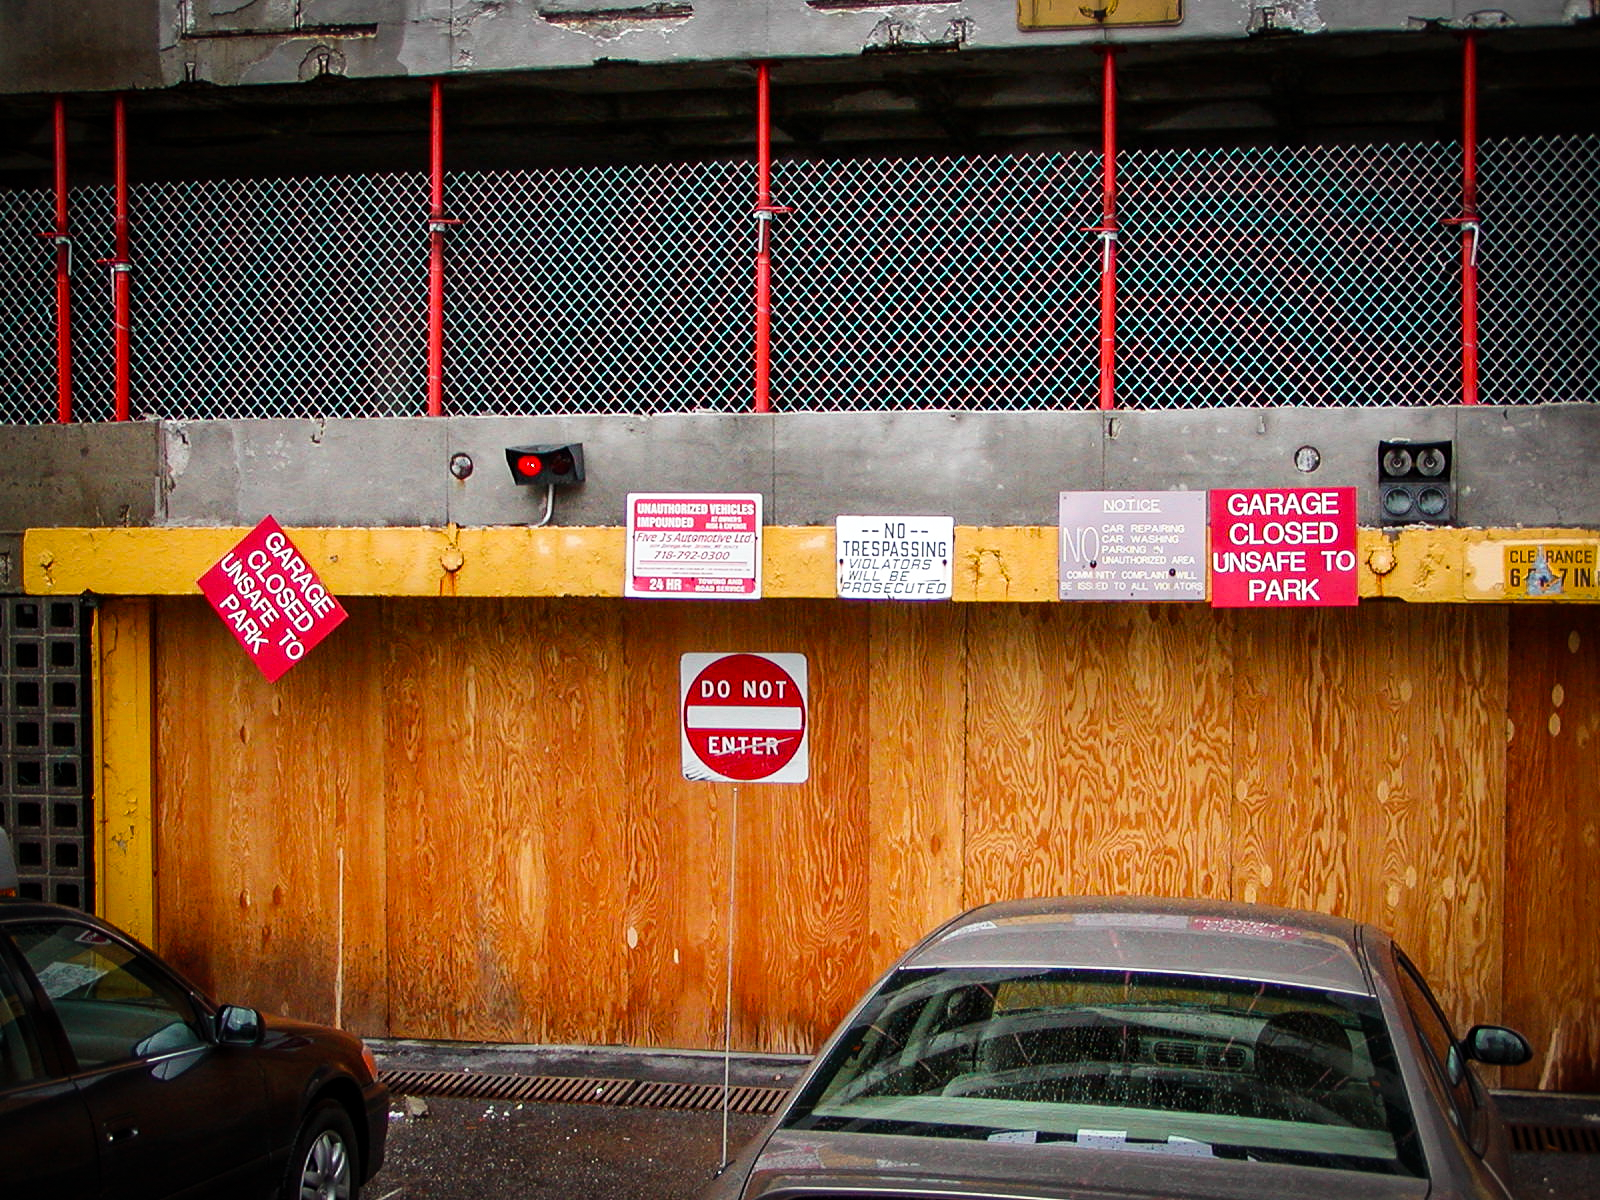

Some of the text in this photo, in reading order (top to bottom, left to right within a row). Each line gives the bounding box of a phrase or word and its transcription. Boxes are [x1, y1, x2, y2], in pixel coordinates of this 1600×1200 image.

[637, 503, 754, 515] UNAUTHORIZED VEHICLES
[1103, 499, 1161, 512] NOTICE
[1227, 492, 1339, 516] GARAGE
[637, 517, 694, 528] IMPOUNDED
[1101, 525, 1185, 533] CAR REPAIRING
[636, 532, 657, 542] Five
[672, 533, 732, 543] Automotive
[1101, 535, 1179, 544] CAR WASHING
[1229, 521, 1339, 545] CLOSED
[843, 540, 946, 557] TRESPASSING
[1063, 526, 1099, 563] NO
[1101, 545, 1146, 554] PARKING
[654, 551, 730, 560] 718-792-0300
[1101, 556, 1195, 564] UNAUTHORIZED AREA
[1212, 550, 1356, 573] UNSAFE TO
[1510, 550, 1592, 563] CLERANCE
[849, 559, 932, 570] VIOLATORS
[265, 532, 335, 619] GARAGE
[849, 570, 910, 581] WILL BE
[1066, 571, 1197, 580] COMMNITY COMPLAINT WILL
[1510, 568, 1520, 587] 6
[248, 550, 314, 632] CLOSED
[649, 579, 682, 591] 24 HR
[841, 582, 947, 594] PROSECUTED
[1060, 582, 1072, 590] BE
[1077, 582, 1108, 590] ISSED
[1114, 582, 1127, 590] TO
[1131, 582, 1149, 590] ALL
[1248, 578, 1320, 601] PARK
[220, 553, 304, 660] UNSAFE TO
[219, 593, 269, 655] PARK
[701, 680, 787, 699] DO NOT
[708, 736, 779, 755] ENTER
